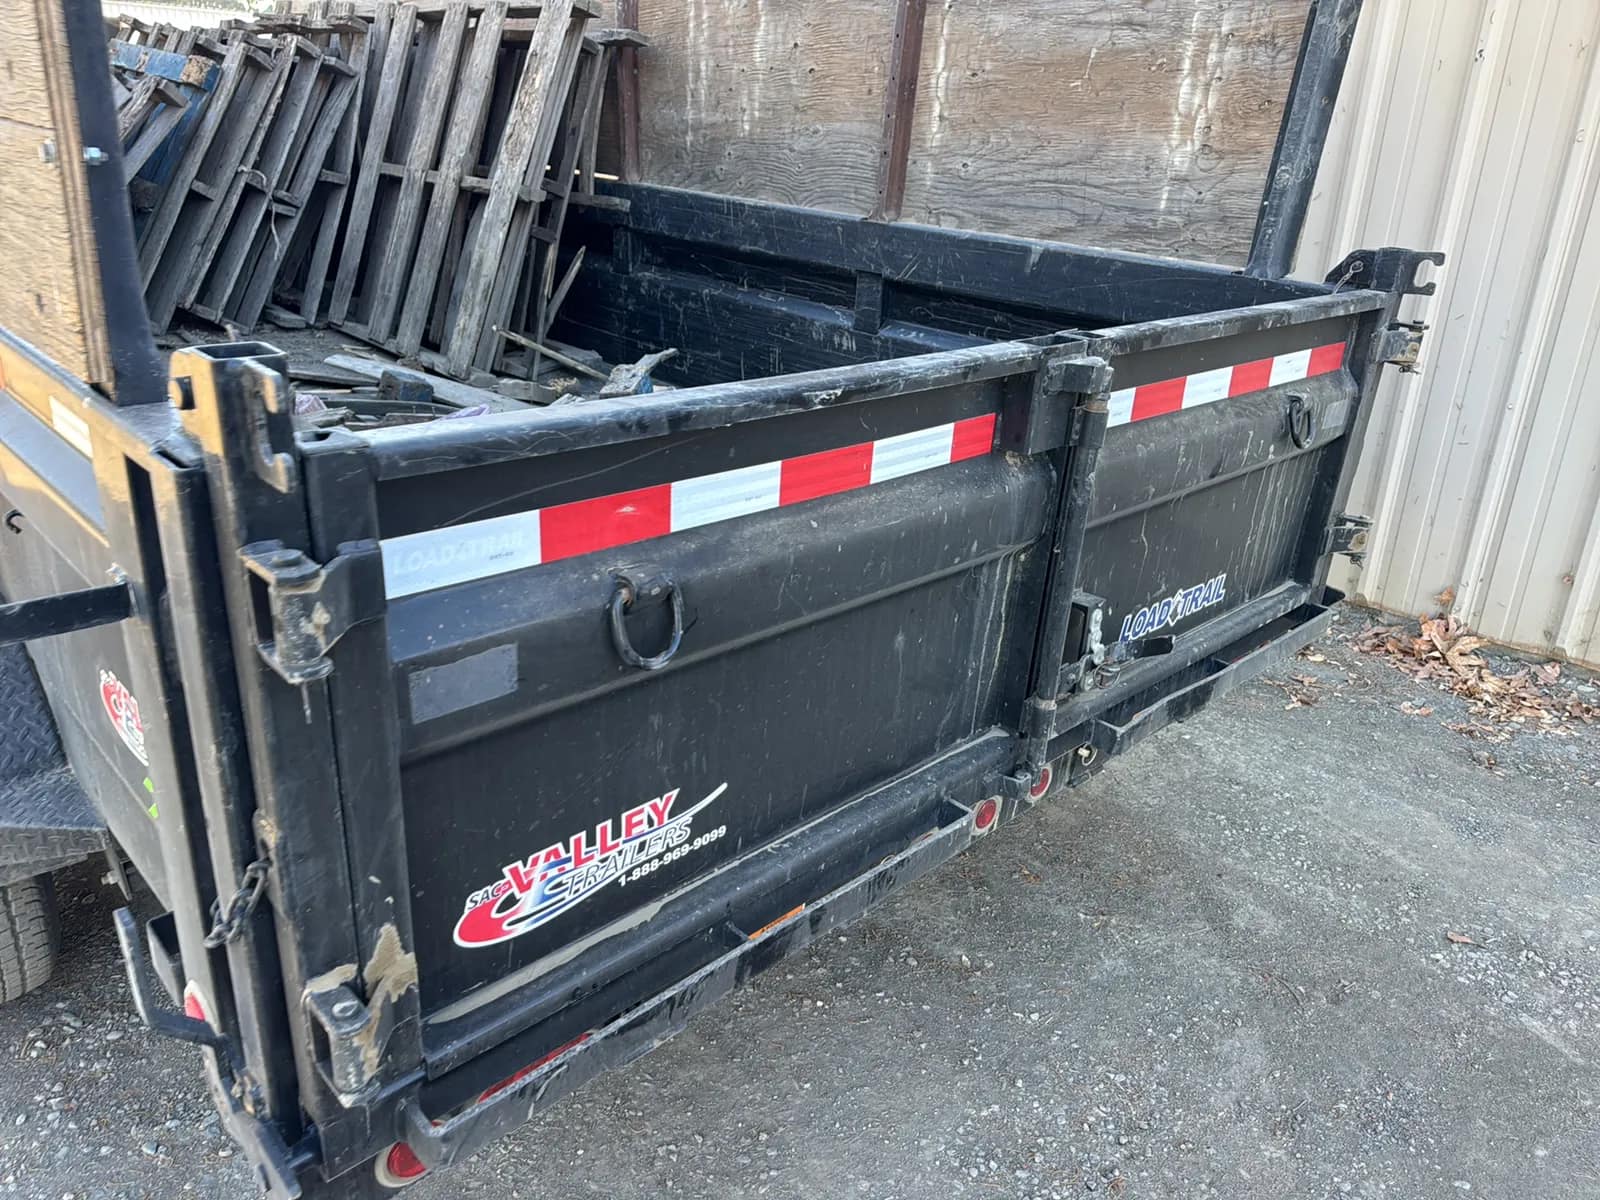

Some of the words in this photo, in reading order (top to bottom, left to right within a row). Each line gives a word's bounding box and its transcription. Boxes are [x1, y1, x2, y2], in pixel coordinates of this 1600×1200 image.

[1119, 597, 1173, 642] LOAD
[1179, 573, 1227, 619] TRAIL
[466, 879, 507, 911] SAC
[503, 789, 679, 899] VALLEY
[566, 816, 692, 898] TRAILERS
[618, 825, 727, 887] 1-888-969-9099
